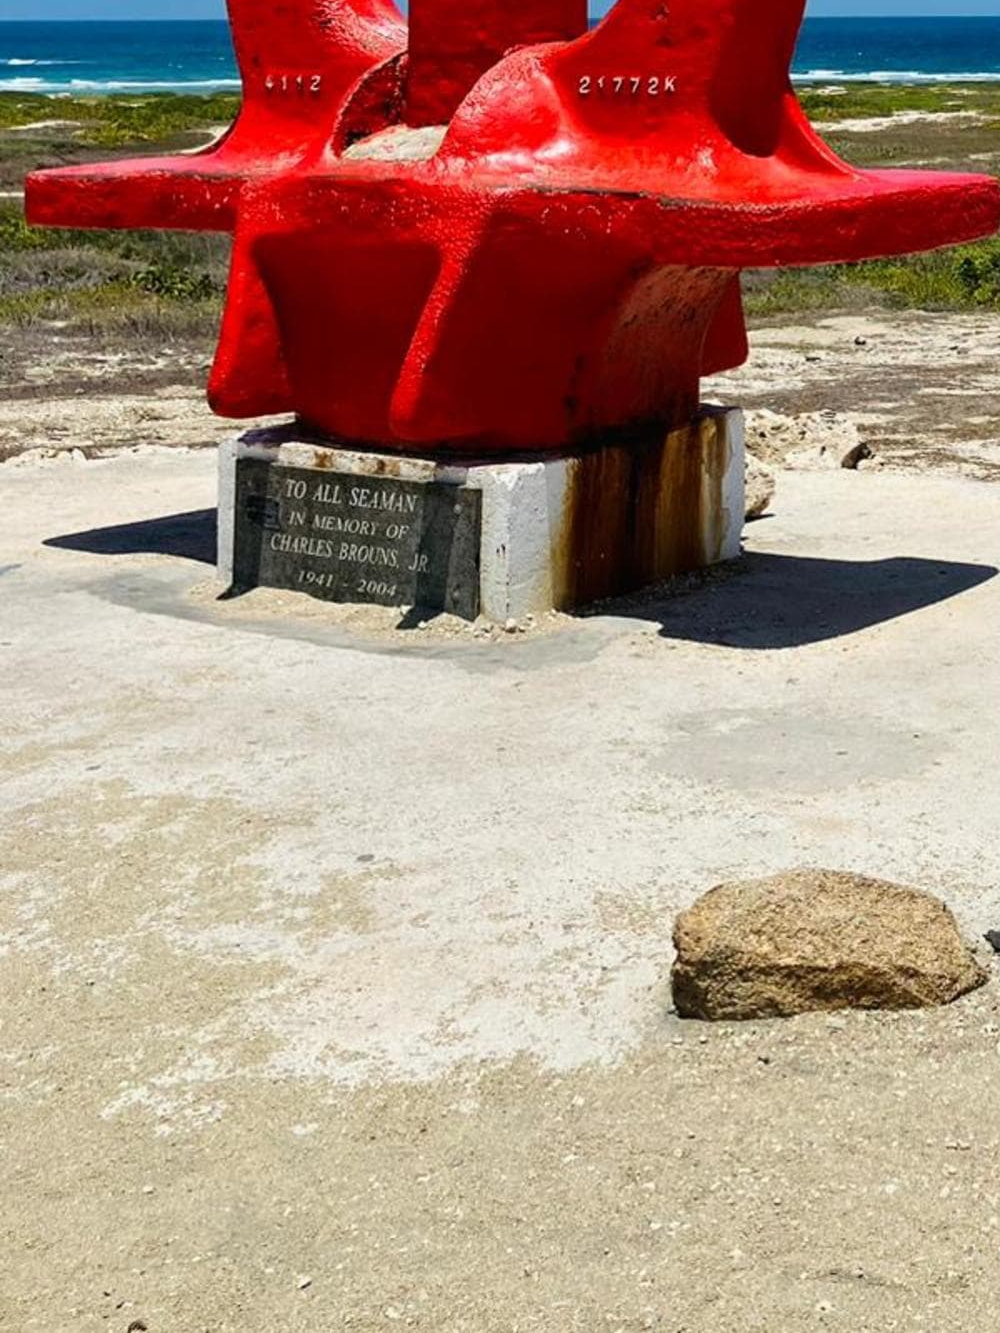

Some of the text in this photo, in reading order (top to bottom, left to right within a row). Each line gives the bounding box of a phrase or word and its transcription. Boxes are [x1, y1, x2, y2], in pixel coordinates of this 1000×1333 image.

[285, 479, 417, 513] TO ALL SEAMAN
[289, 511, 409, 539] IN MEMORY OF
[270, 533, 334, 558] CHARLES
[298, 570, 333, 587] 1941
[357, 579, 397, 597] 2004
